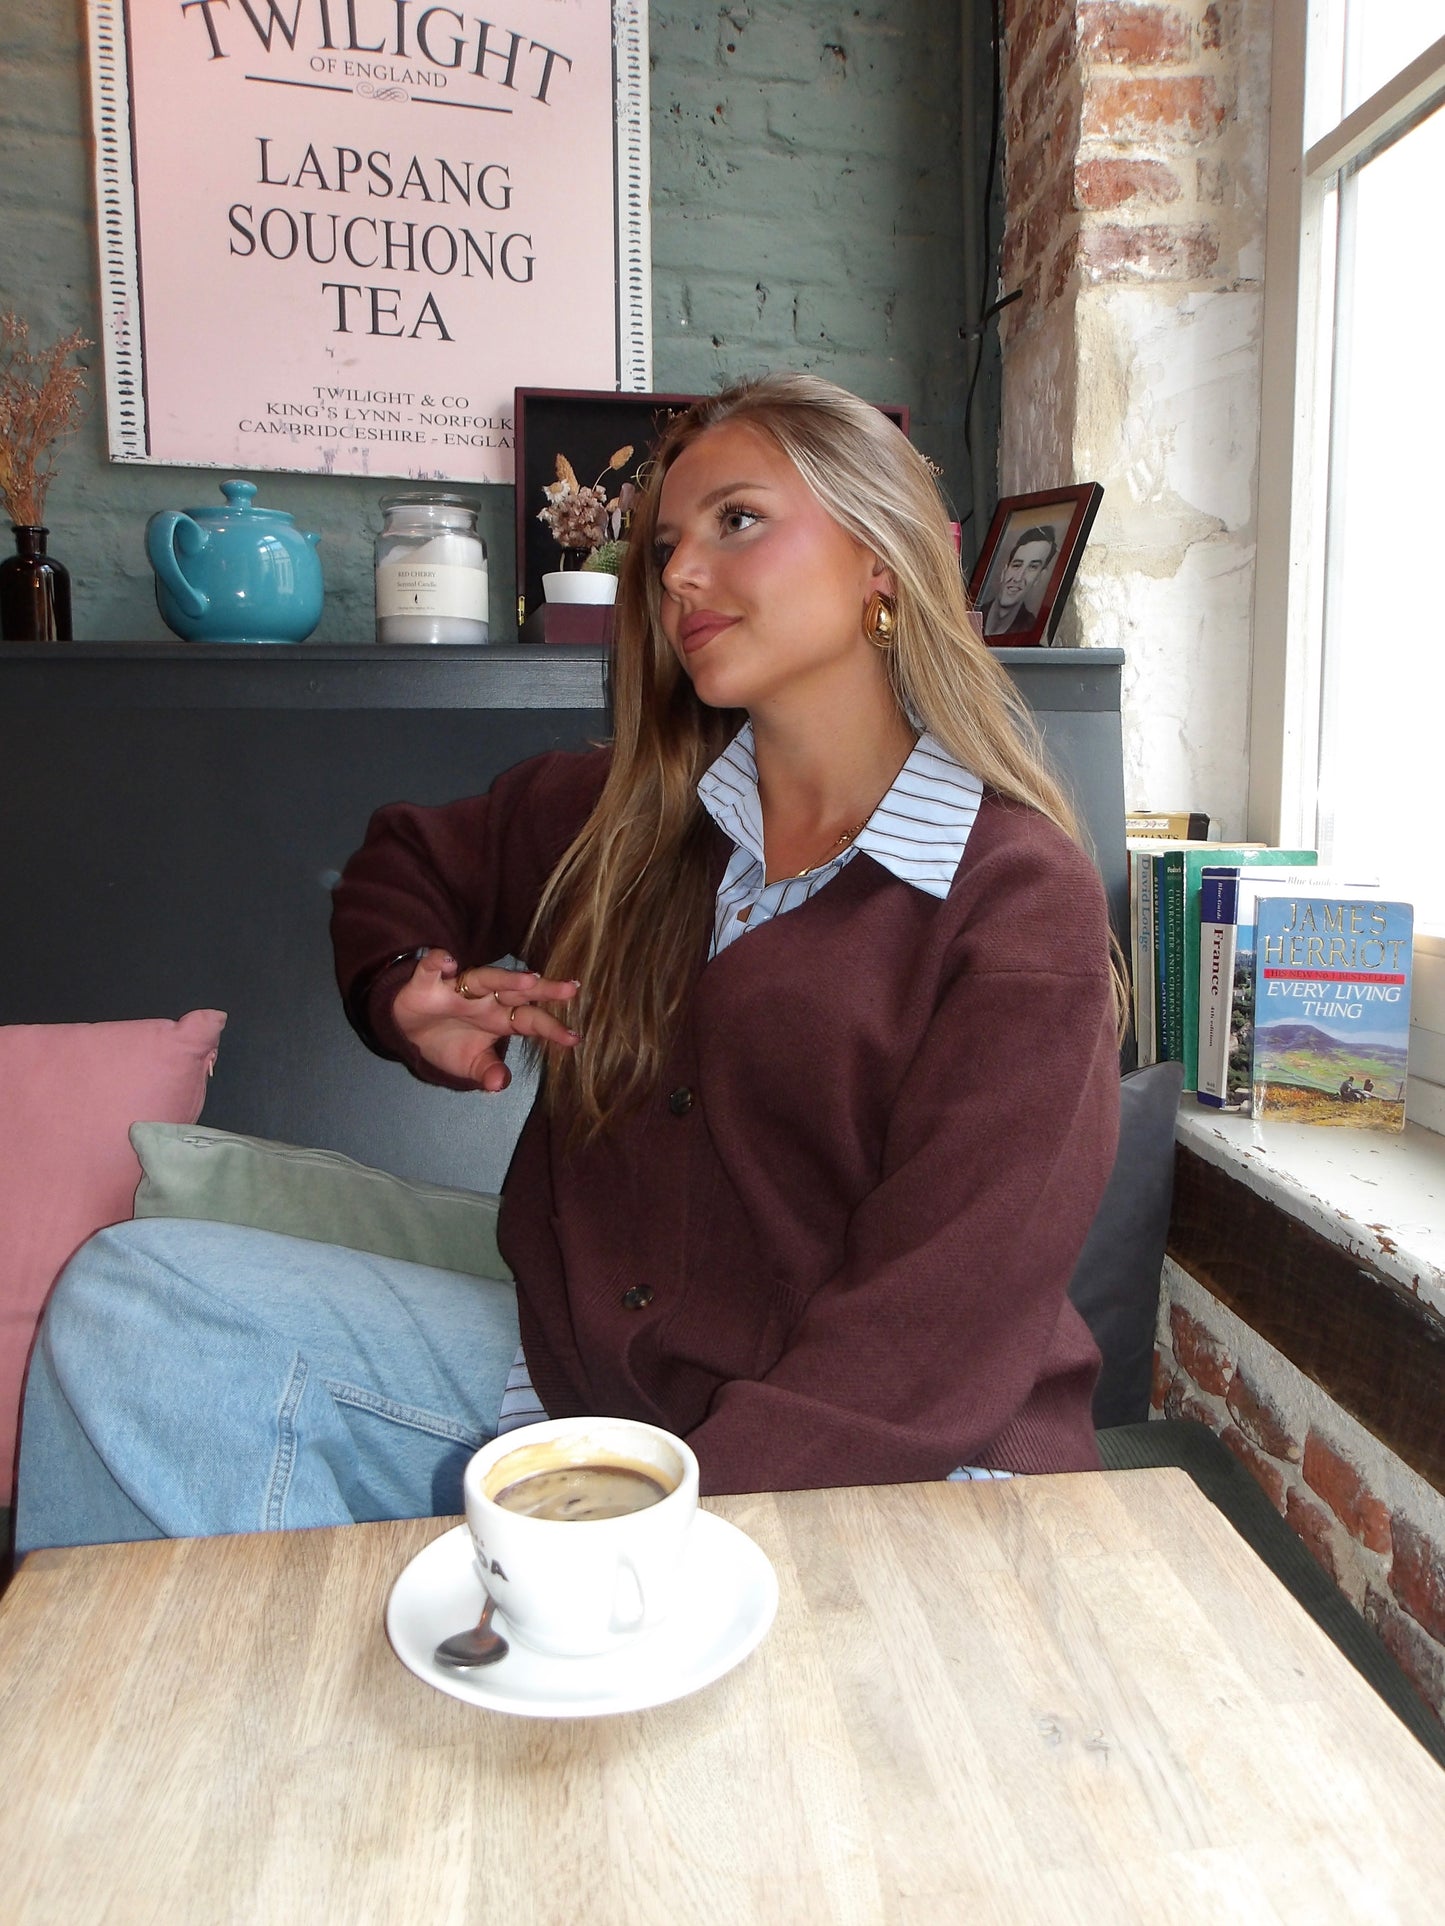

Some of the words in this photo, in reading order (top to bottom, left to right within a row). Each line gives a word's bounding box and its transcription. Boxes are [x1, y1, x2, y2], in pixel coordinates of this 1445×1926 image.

[181, 0, 572, 106] TWILIGHT
[309, 55, 337, 75] OF
[343, 59, 448, 89] ENGLAND
[254, 136, 514, 211] LAPSANG
[227, 203, 537, 283] SOUCHONG
[321, 281, 456, 343] TEA
[313, 385, 415, 406] TWILIGHT
[420, 394, 435, 407] &
[441, 395, 469, 409] CO
[266, 402, 338, 420] KING'S
[345, 407, 401, 424] LYNN
[419, 412, 514, 431] NORFOLK
[444, 432, 516, 449] ENGLA
[1141, 858, 1150, 902] David
[1139, 906, 1150, 953] Lodge
[1282, 903, 1388, 936] JAMES
[1211, 929, 1223, 996] France
[1263, 935, 1406, 970] HERRIOT
[1267, 982, 1330, 998] EVERY
[1335, 985, 1402, 1002] LIVING
[1169, 1016, 1175, 1027] IN
[1302, 1001, 1363, 1018] THING
